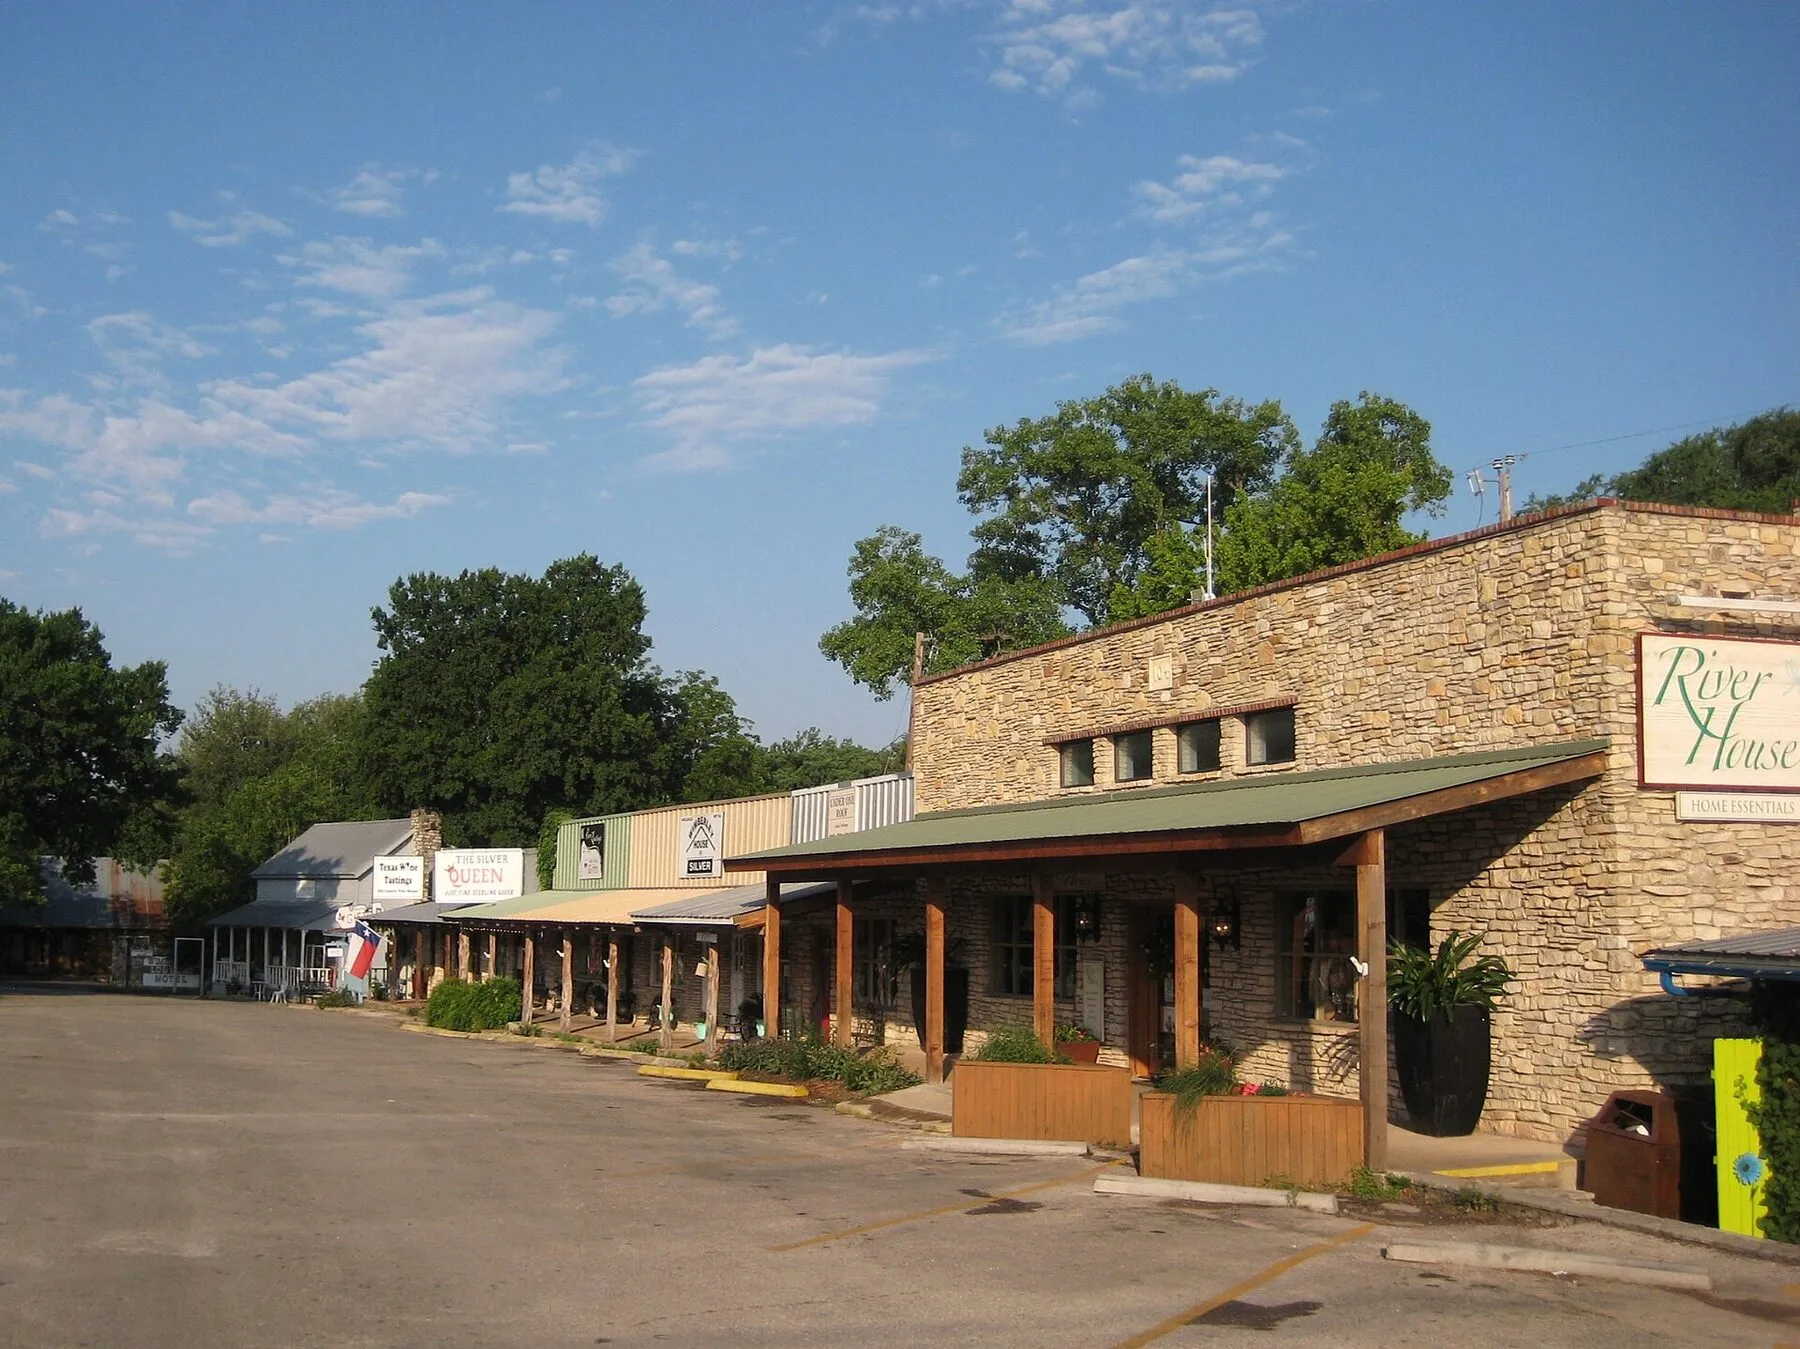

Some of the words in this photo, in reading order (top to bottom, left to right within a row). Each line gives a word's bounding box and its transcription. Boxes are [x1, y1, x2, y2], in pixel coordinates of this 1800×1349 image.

[1652, 646, 1773, 740] River
[1685, 700, 1800, 772] House
[1691, 799, 1728, 813] HOME
[1731, 800, 1795, 815] ESSENTIALS
[694, 839, 709, 849] HOUSE
[455, 855, 475, 864] THE
[476, 854, 508, 864] SILVER
[379, 863, 398, 871] Texas
[689, 861, 711, 871] SILVER
[384, 876, 412, 885] Tastings
[449, 867, 503, 887] QUEEN
